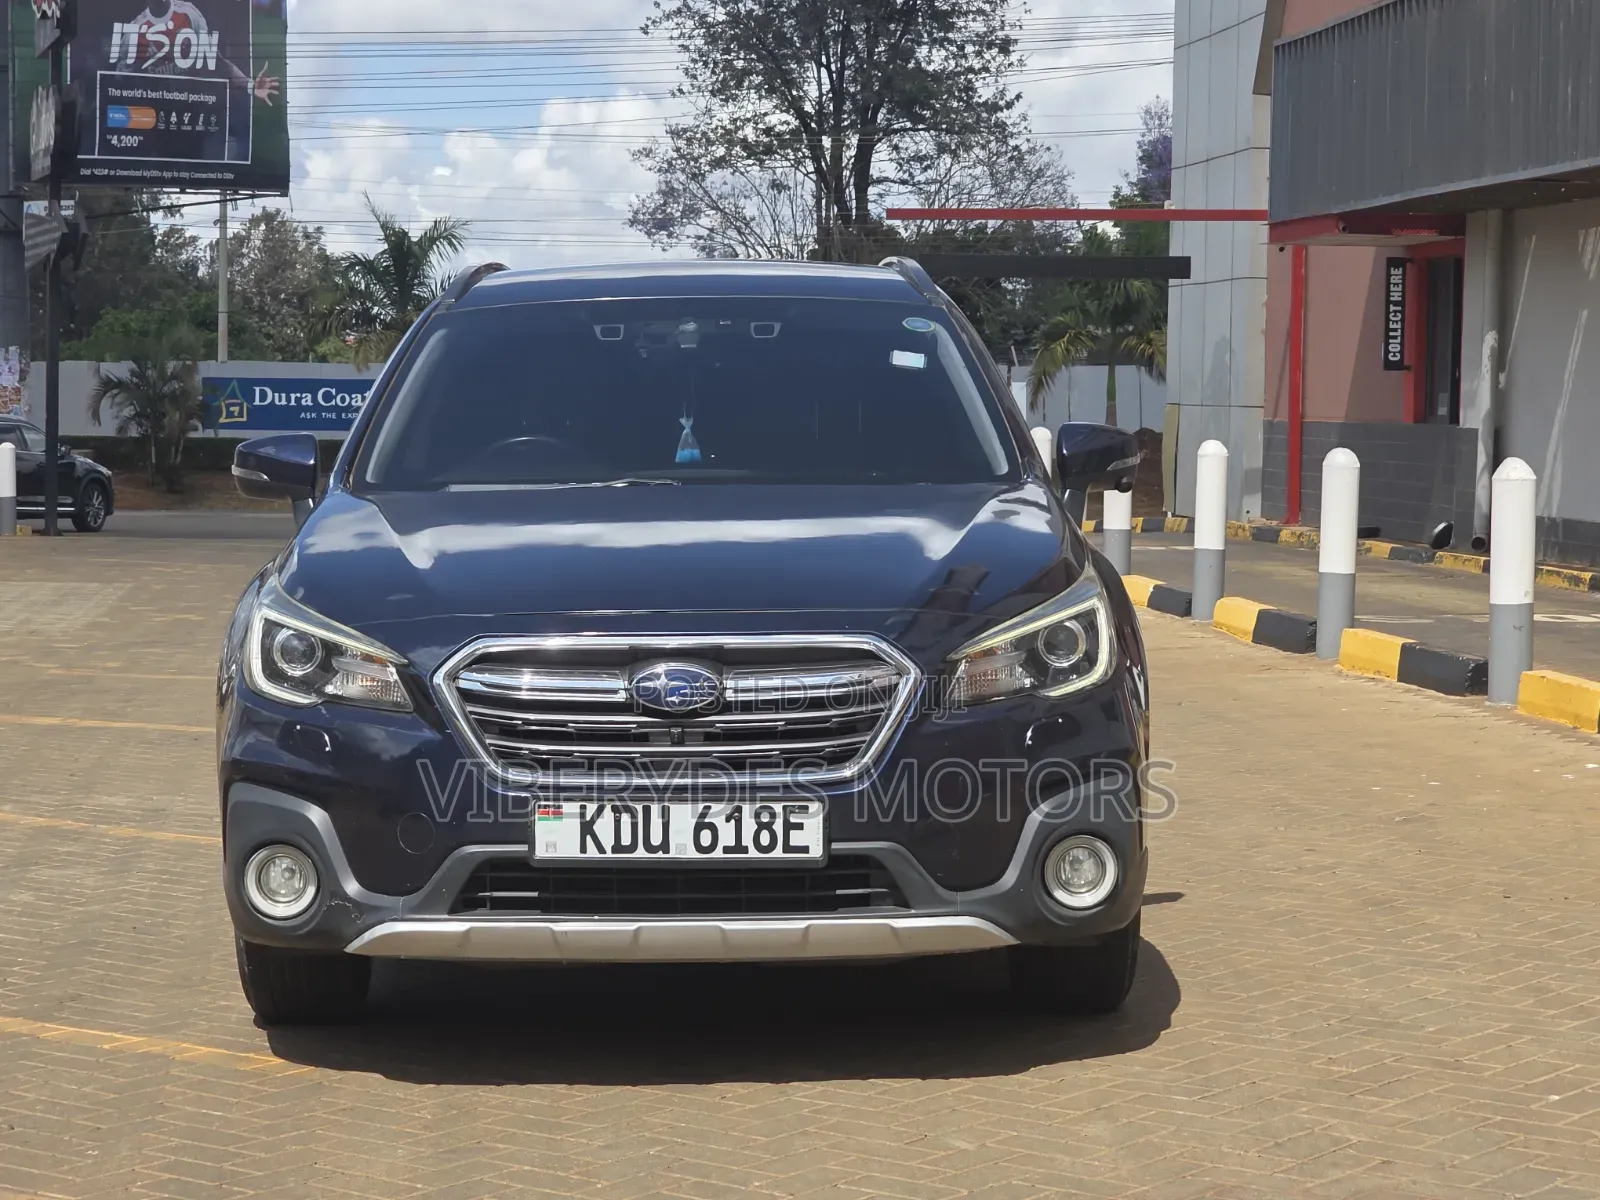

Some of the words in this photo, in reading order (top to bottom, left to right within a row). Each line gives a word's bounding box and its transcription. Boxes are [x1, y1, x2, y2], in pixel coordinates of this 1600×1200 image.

[109, 21, 174, 69] IT'S
[174, 28, 219, 70] ON
[108, 87, 121, 97] The
[122, 89, 147, 98] world's
[148, 90, 162, 99] best
[163, 91, 188, 101] football
[189, 93, 216, 104] package
[116, 169, 142, 177] Download
[162, 170, 173, 179] App
[1390, 267, 1403, 301] HERE
[1388, 304, 1402, 361] COLLECT
[253, 386, 313, 407] Dura
[579, 804, 670, 854] KDU
[693, 804, 810, 854] 618E
